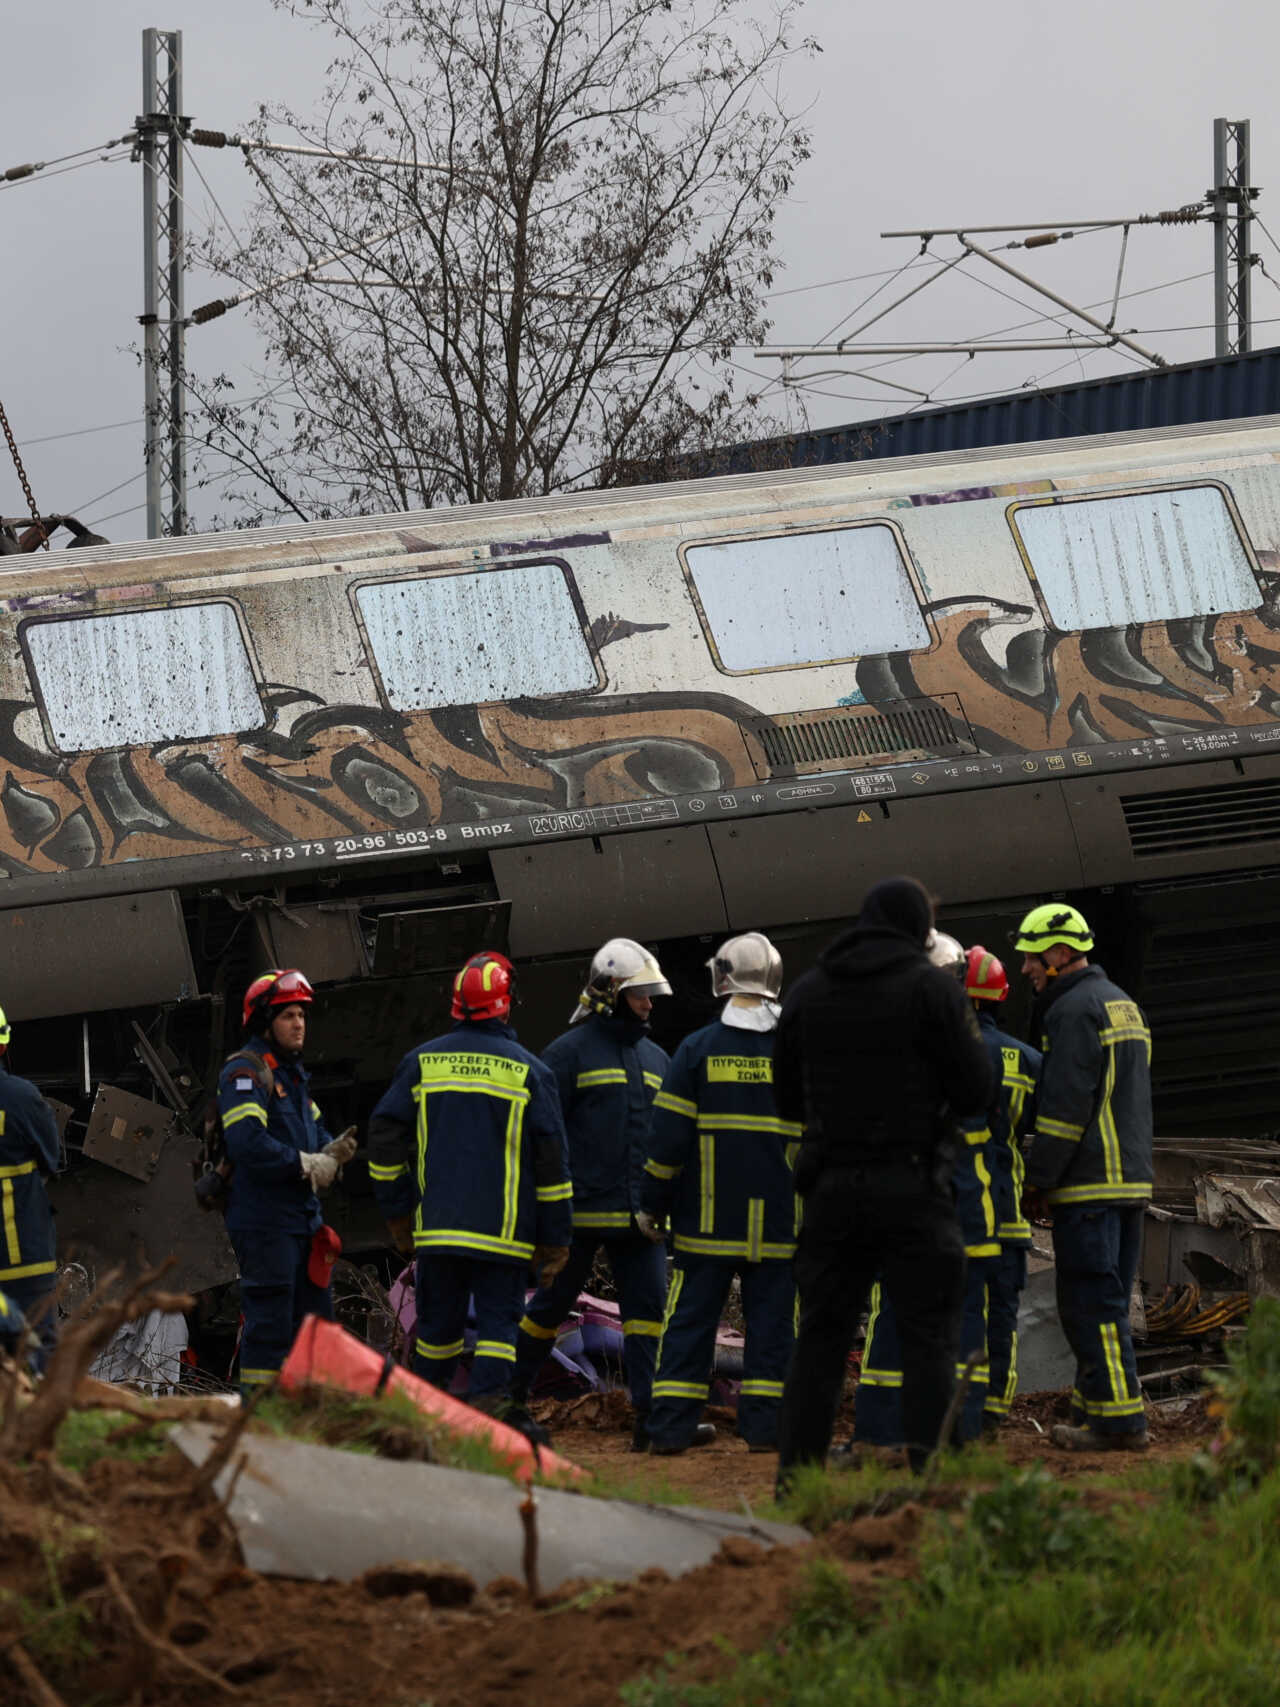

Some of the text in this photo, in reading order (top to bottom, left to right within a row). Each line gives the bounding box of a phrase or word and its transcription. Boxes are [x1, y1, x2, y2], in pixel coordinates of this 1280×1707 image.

[272, 846, 296, 860] 73
[301, 843, 326, 857] 73
[334, 835, 386, 853] 20-96
[394, 828, 448, 845] 503-8
[460, 822, 513, 839] Bmpz
[421, 1054, 525, 1074] ΠΥΡΟΣΒΕΣΤΙΚΟ
[450, 1065, 491, 1077] ΣΩΜΑ
[712, 1057, 774, 1070] ΠΥΡΟΣΒΕΣΤ
